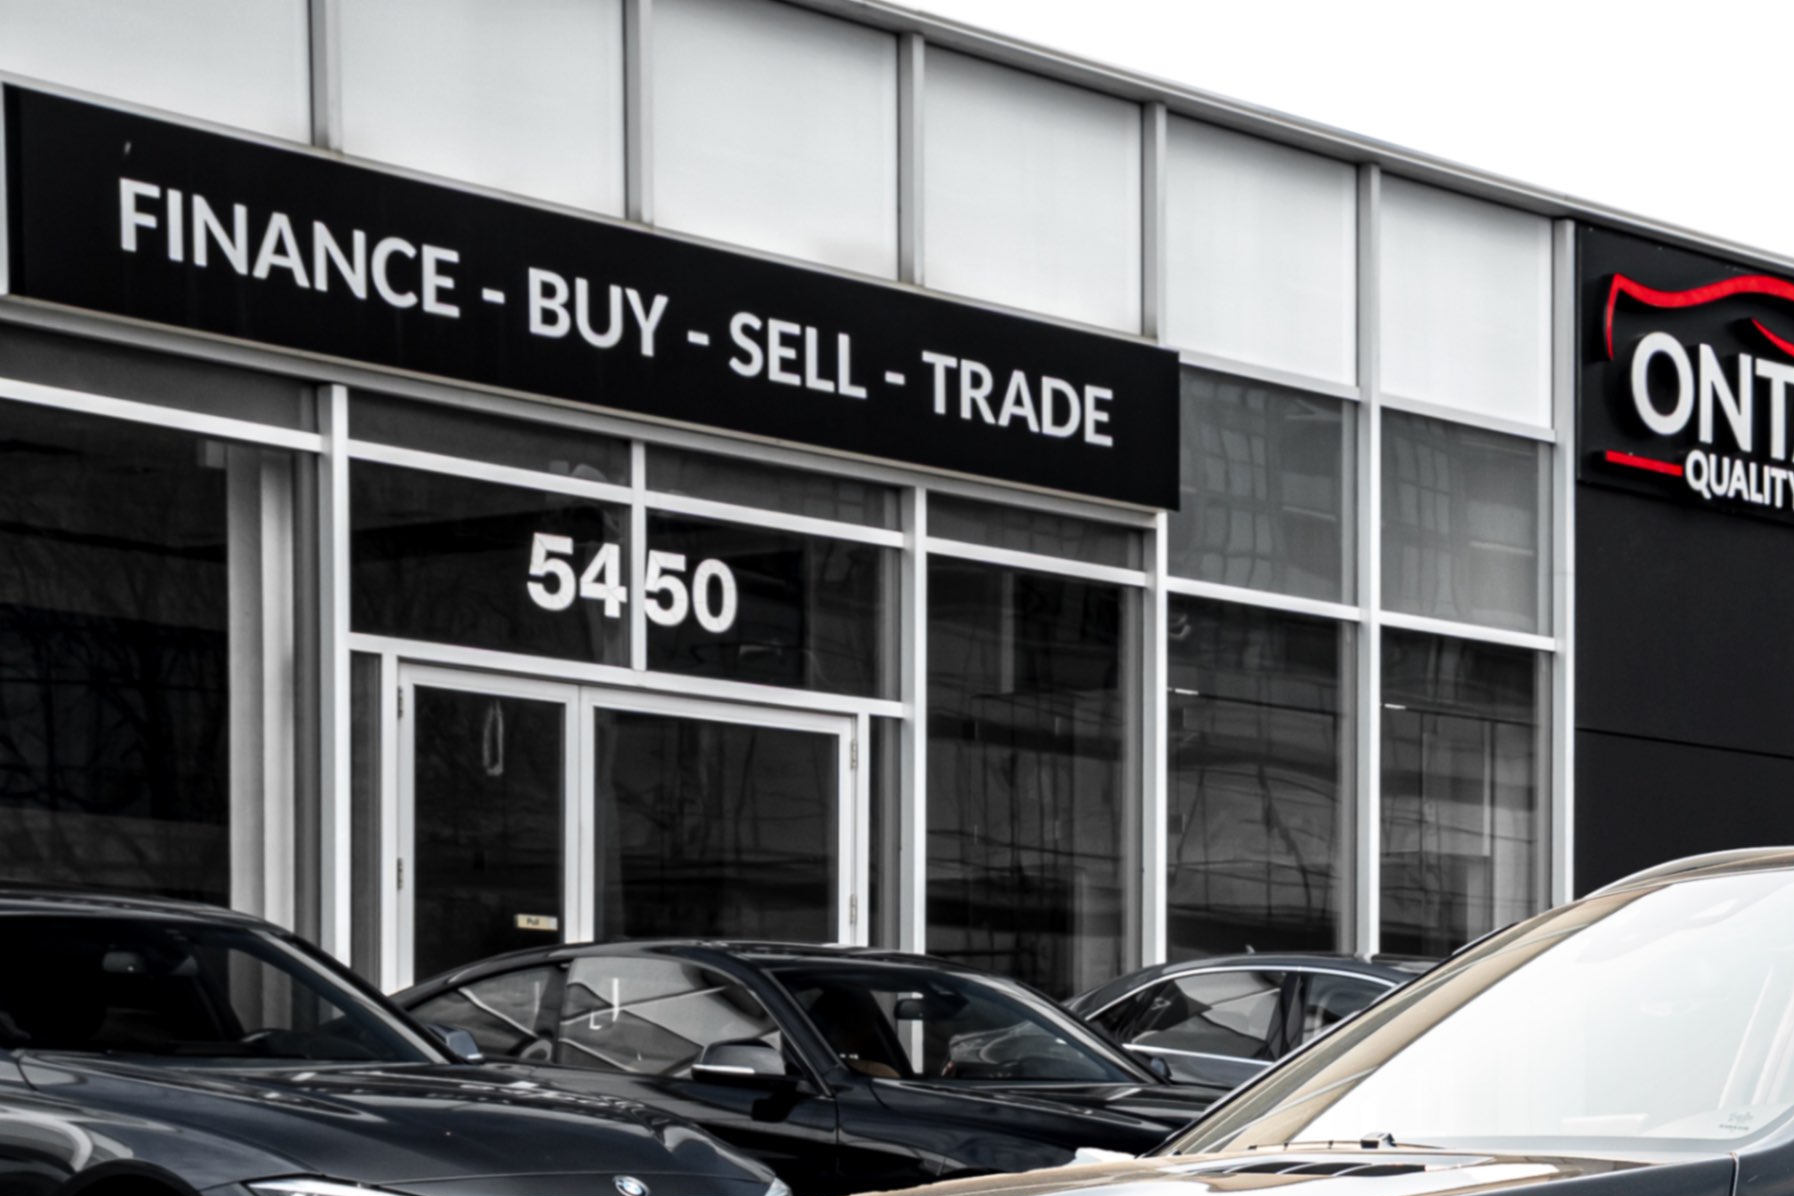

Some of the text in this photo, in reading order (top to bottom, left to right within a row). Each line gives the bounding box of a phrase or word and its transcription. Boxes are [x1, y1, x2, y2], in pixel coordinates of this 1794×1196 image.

[119, 177, 460, 319] FINANCE
[527, 266, 669, 357] BUY
[728, 311, 868, 400] SELL
[921, 350, 1114, 448] TRADE
[526, 532, 739, 635] 5450
